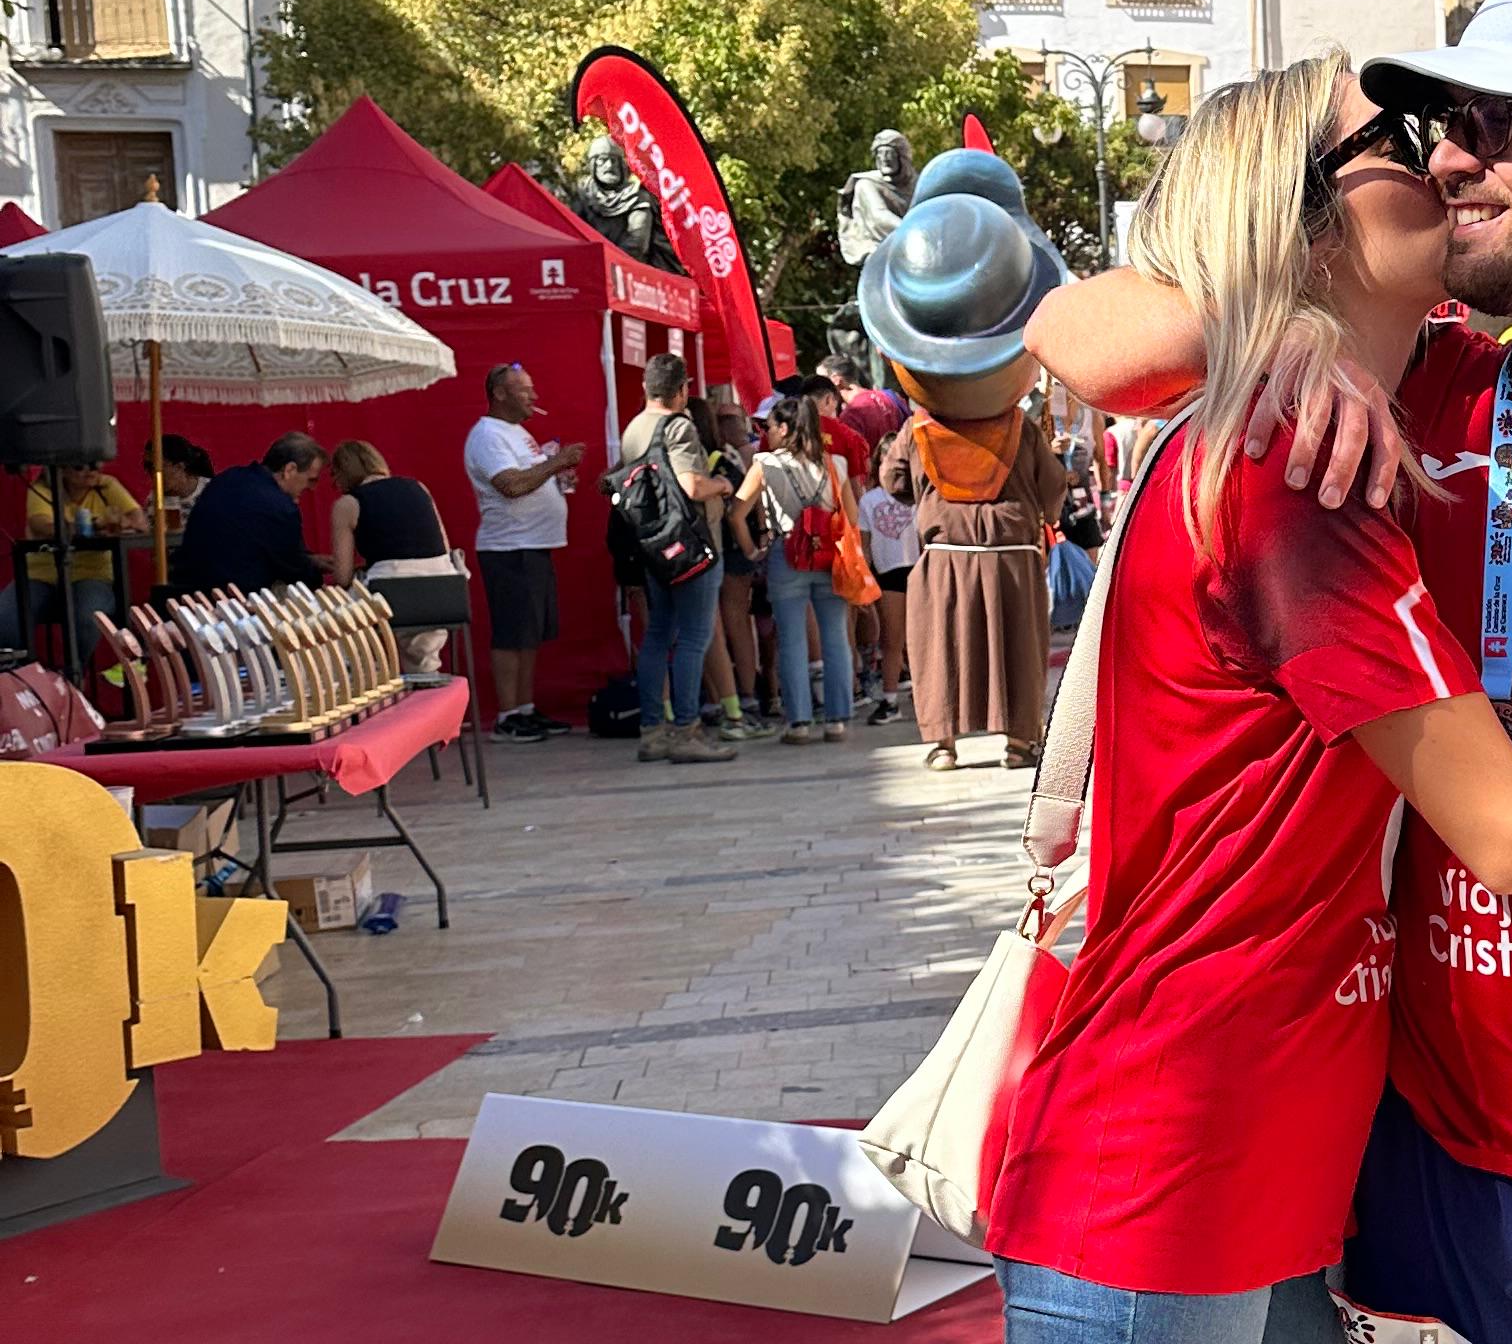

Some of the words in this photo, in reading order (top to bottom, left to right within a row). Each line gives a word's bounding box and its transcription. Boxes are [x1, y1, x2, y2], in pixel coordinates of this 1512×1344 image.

[410, 271, 513, 307] Cruz
[500, 1144, 630, 1237] 90k
[714, 1169, 854, 1267] 90k
